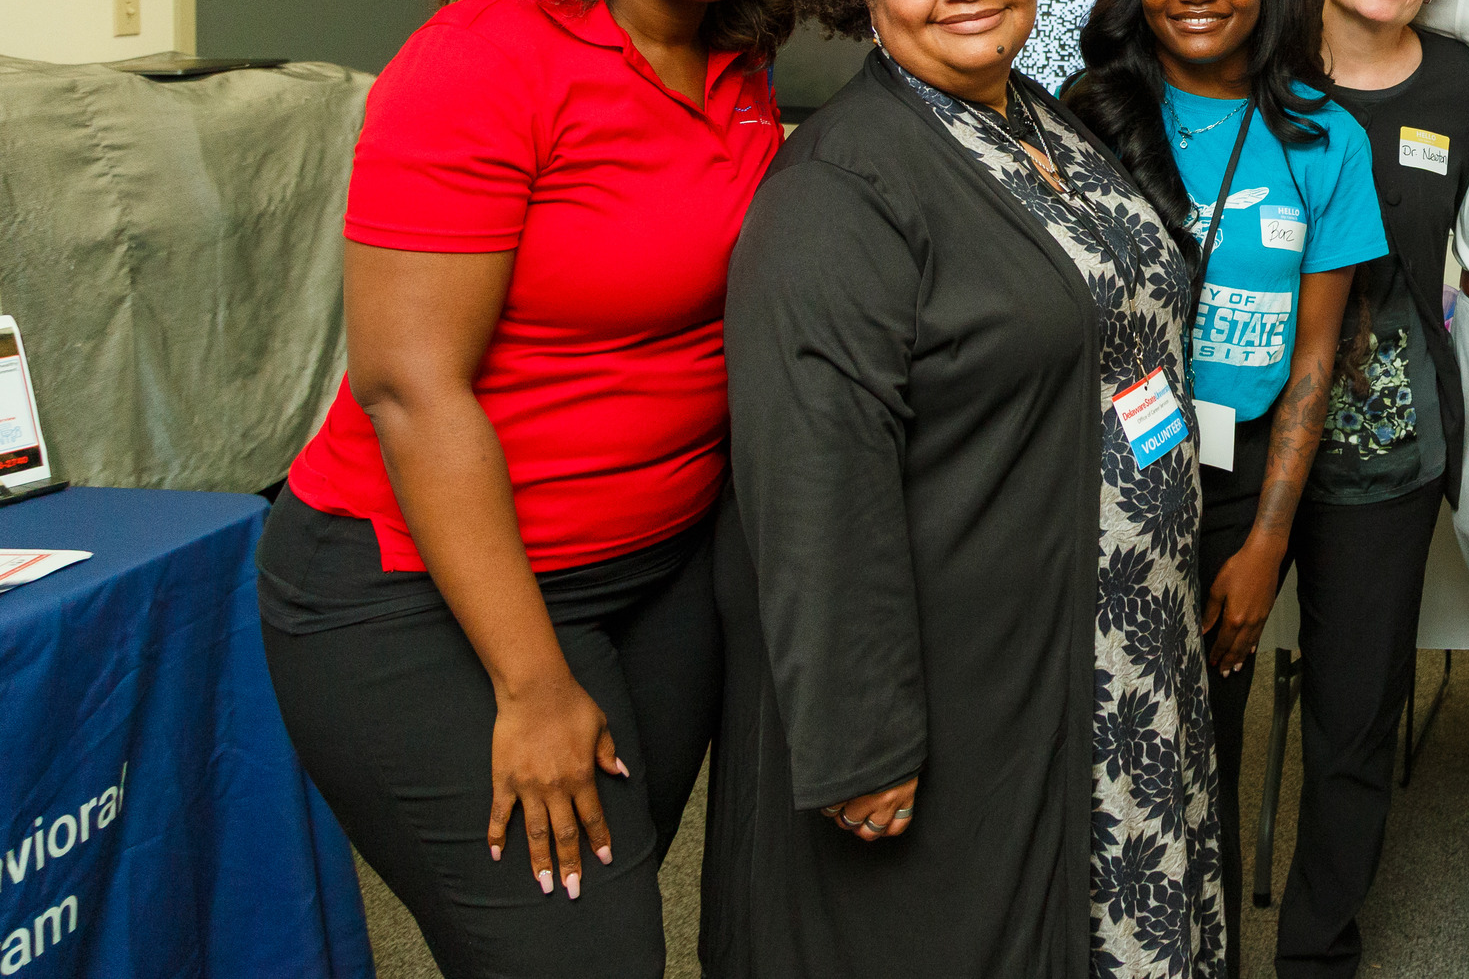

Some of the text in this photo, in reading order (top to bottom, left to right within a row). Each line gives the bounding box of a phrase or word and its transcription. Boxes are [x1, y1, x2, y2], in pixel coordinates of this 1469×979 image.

[1416, 130, 1437, 141] HELLO
[1401, 144, 1418, 157] Dr.
[1278, 207, 1300, 217] HELLO
[1229, 293, 1257, 307] OF
[1210, 307, 1289, 347] STATE
[1198, 345, 1279, 362] SITY
[1141, 417, 1183, 454] VOLUNTEER
[0, 761, 128, 893] vioral
[0, 895, 78, 976] am
